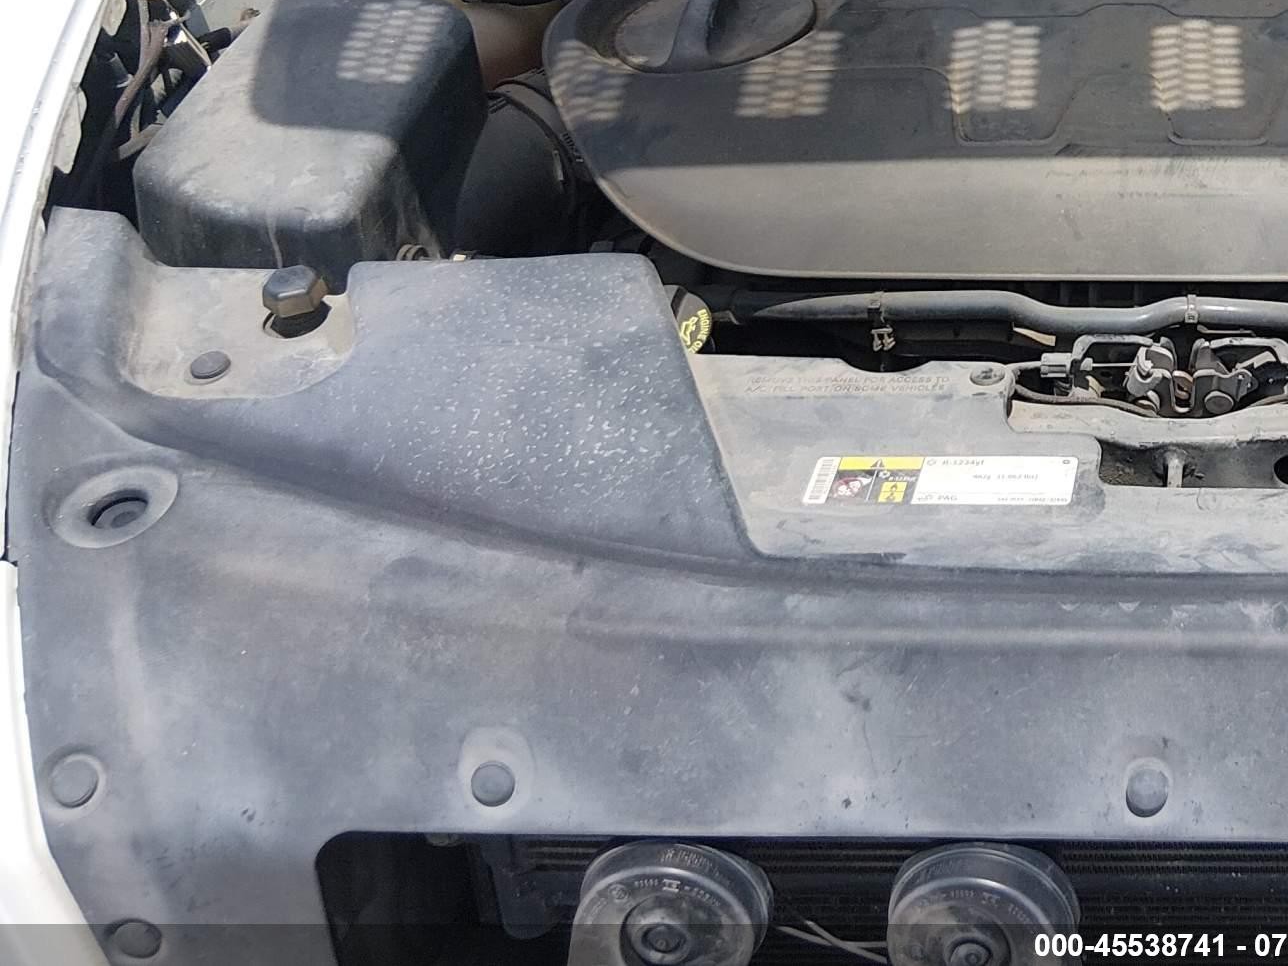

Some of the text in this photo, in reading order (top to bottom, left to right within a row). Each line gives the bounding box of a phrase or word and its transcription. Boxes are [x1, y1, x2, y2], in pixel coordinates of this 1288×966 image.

[696, 309, 711, 341] ENGINE
[889, 376, 932, 384] ACCESS
[935, 376, 949, 384] TO
